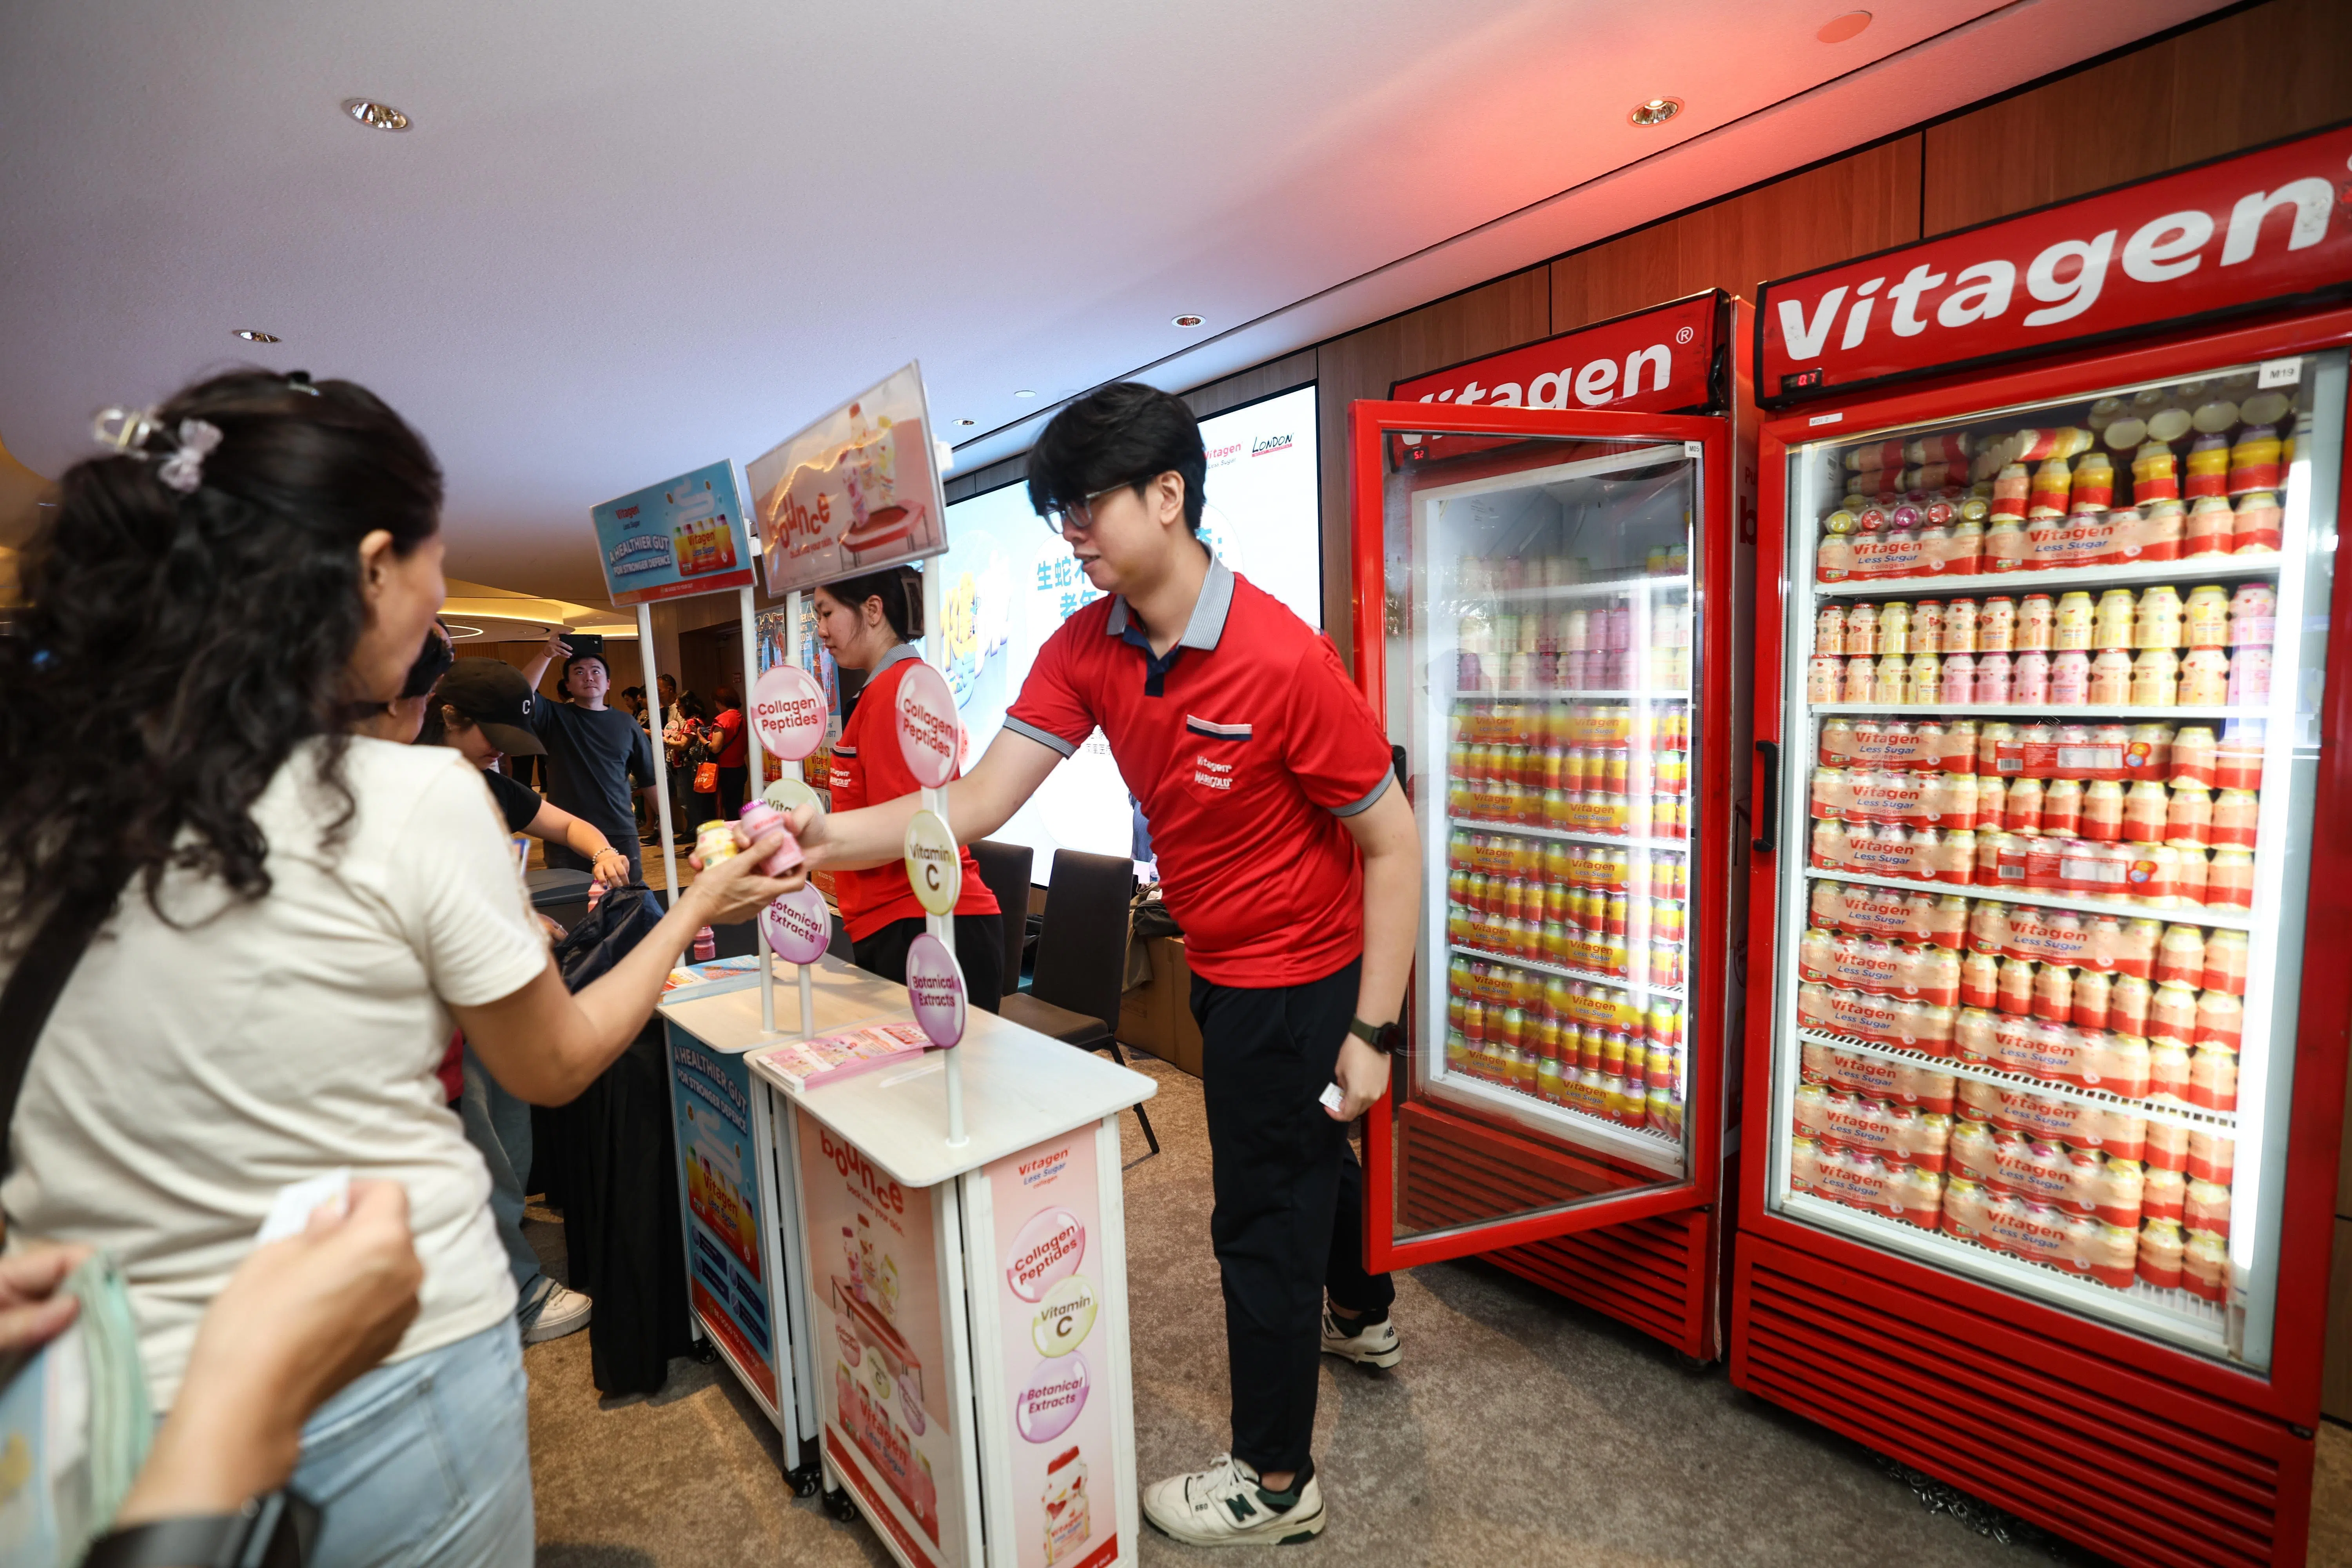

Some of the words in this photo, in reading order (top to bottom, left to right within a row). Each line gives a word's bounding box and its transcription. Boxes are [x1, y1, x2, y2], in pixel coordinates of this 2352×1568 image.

[1778, 177, 2334, 361] Vitagen
[2270, 368, 2294, 378] M19
[615, 505, 639, 520] Vitagen
[687, 532, 715, 546] Vitagen
[2030, 526, 2114, 542] Vitagen
[609, 551, 615, 564] A
[615, 535, 652, 561] HEALTHIER
[653, 535, 669, 550] GUT
[1854, 543, 1922, 554] Vitagen
[2067, 541, 2108, 549] Sugar
[614, 564, 623, 575] FOR
[623, 559, 649, 573] STRONGER
[649, 555, 671, 568] DEFENCE
[523, 700, 530, 715] C
[758, 698, 817, 715] Collagen
[761, 713, 818, 733] Peptides
[903, 698, 953, 739] Collagen
[902, 719, 950, 758] Peptides
[1856, 732, 1920, 745] Vitagen
[1884, 746, 1915, 755] Sugar
[1474, 793, 1513, 804] Vitagen
[1853, 786, 1919, 800] Vitagen
[767, 798, 792, 811] Vita
[1570, 804, 1615, 814] Vitagen
[1882, 800, 1915, 810] Sugar
[910, 844, 950, 862] Vitamin
[1475, 847, 1514, 858] Vitagen
[1850, 839, 1915, 855] Vitagen
[1572, 859, 1615, 871] Vitagen
[1854, 852, 1876, 860] Less
[1878, 854, 1910, 865] Sugar
[926, 865, 940, 890] C
[1845, 898, 1911, 916] Vitagen
[768, 900, 823, 933] Botanical
[1849, 911, 1872, 920] Less
[1874, 915, 1906, 926] Sugar
[770, 911, 815, 943] Extracts
[1472, 923, 1511, 937] Vitagen
[2009, 921, 2087, 942] Vitagen
[1570, 940, 1613, 955] Vitagen
[2014, 935, 2042, 945] Less
[2044, 939, 2082, 952] Sugar
[1834, 952, 1897, 971] Vitagen
[1838, 965, 1860, 974] Less
[1862, 969, 1893, 980] Sugar
[912, 975, 955, 989] Botanical
[1474, 975, 1513, 989] Vitagen
[919, 993, 955, 1007] Extracts
[1572, 995, 1616, 1012] Vitagen
[1831, 999, 1895, 1021] Vitagen
[1835, 1013, 1857, 1022] Less
[1859, 1017, 1891, 1029] Sugar
[1995, 1033, 2074, 1057] Vitagen
[1469, 1050, 1507, 1067] Vitagen
[1835, 1056, 1896, 1078] Vitagen
[674, 1045, 681, 1060] A
[680, 1045, 727, 1092] HEALTHIER
[729, 1084, 748, 1111] GUT
[1838, 1069, 1860, 1078] Less
[1862, 1074, 1893, 1087] Sugar
[1563, 1080, 1607, 1098] Vitagen
[677, 1070, 689, 1085] FOR
[689, 1077, 721, 1109] STRONGER
[721, 1100, 747, 1132] DEFENCE
[1583, 1095, 1604, 1105] Sugar
[2000, 1092, 2077, 1120] Vitagen
[1827, 1111, 1890, 1134] Vitagen
[1830, 1124, 1852, 1134] Less
[1854, 1130, 1885, 1143] Sugar
[1018, 1148, 1069, 1176] Vitagen
[1994, 1154, 2071, 1183] Vitagen
[820, 1129, 903, 1214] bounce
[1023, 1173, 1042, 1185] Less
[1043, 1162, 1066, 1178] Sugar
[1819, 1163, 1883, 1189] Vitagen
[703, 1172, 737, 1216] Vitagen
[1823, 1177, 1845, 1187] Less
[1847, 1183, 1878, 1197] Sugar
[708, 1196, 720, 1214] Less
[721, 1206, 737, 1230] Sugar
[1987, 1210, 2065, 1241] Vitagen
[1015, 1225, 1075, 1272] Collagen
[1041, 1295, 1091, 1321] Vitamin
[1056, 1316, 1073, 1338] C
[1027, 1377, 1083, 1401] Botanical
[1028, 1393, 1076, 1415] Extracts
[859, 1396, 909, 1467] Vitagen
[866, 1424, 882, 1450] Less
[883, 1445, 906, 1478] Sugar
